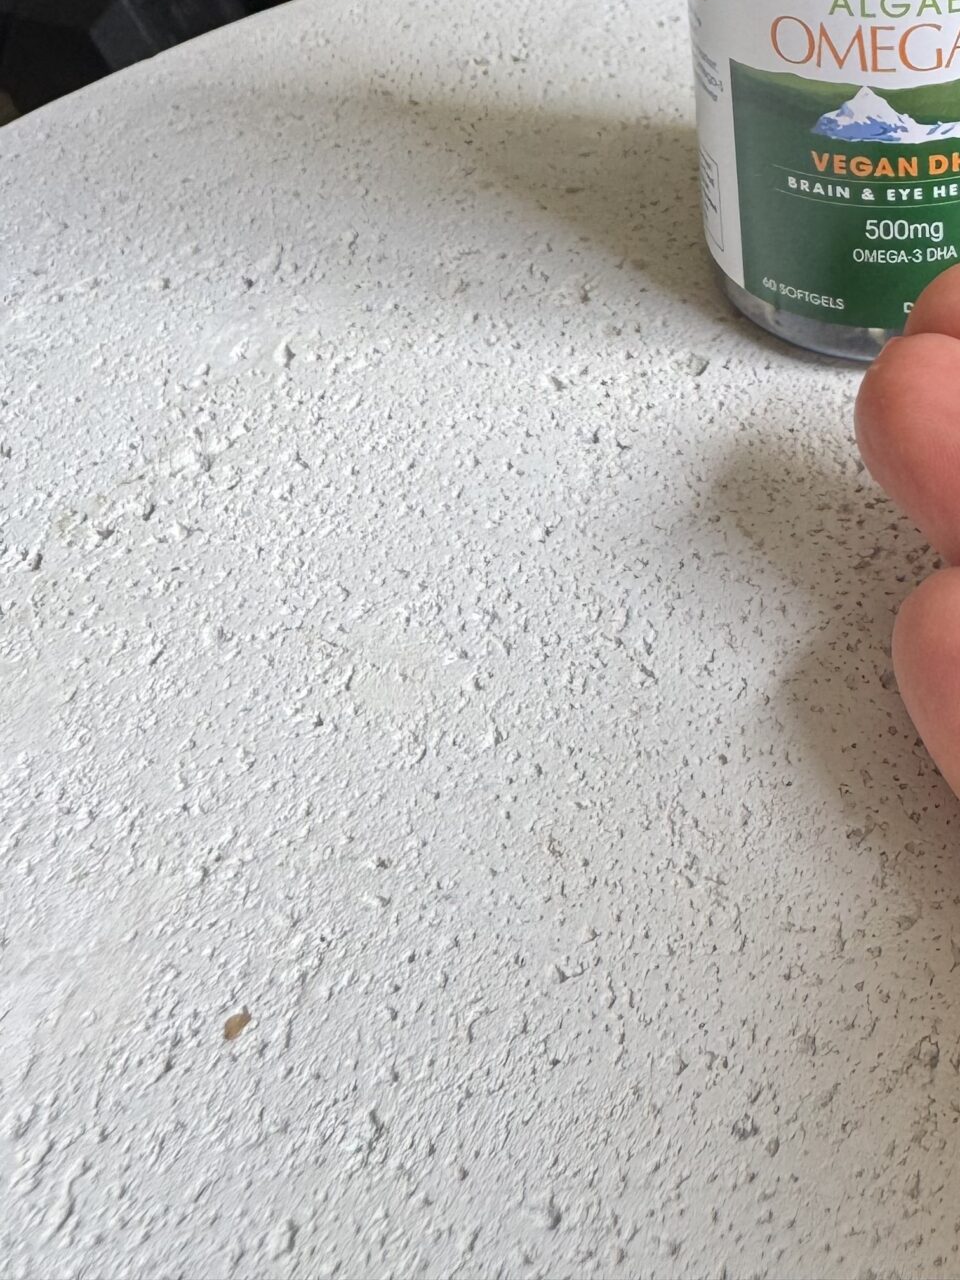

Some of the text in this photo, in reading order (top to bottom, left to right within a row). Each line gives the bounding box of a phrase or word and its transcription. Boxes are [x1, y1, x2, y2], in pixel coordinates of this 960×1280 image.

[810, 150, 918, 177] VEGAN
[787, 176, 850, 200] BRAIN
[861, 188, 875, 201] &
[886, 187, 923, 201] EYE
[865, 219, 945, 241] 500mg
[853, 245, 958, 263] OMEGA-3 DHA
[779, 283, 845, 310] SOFTGELS
